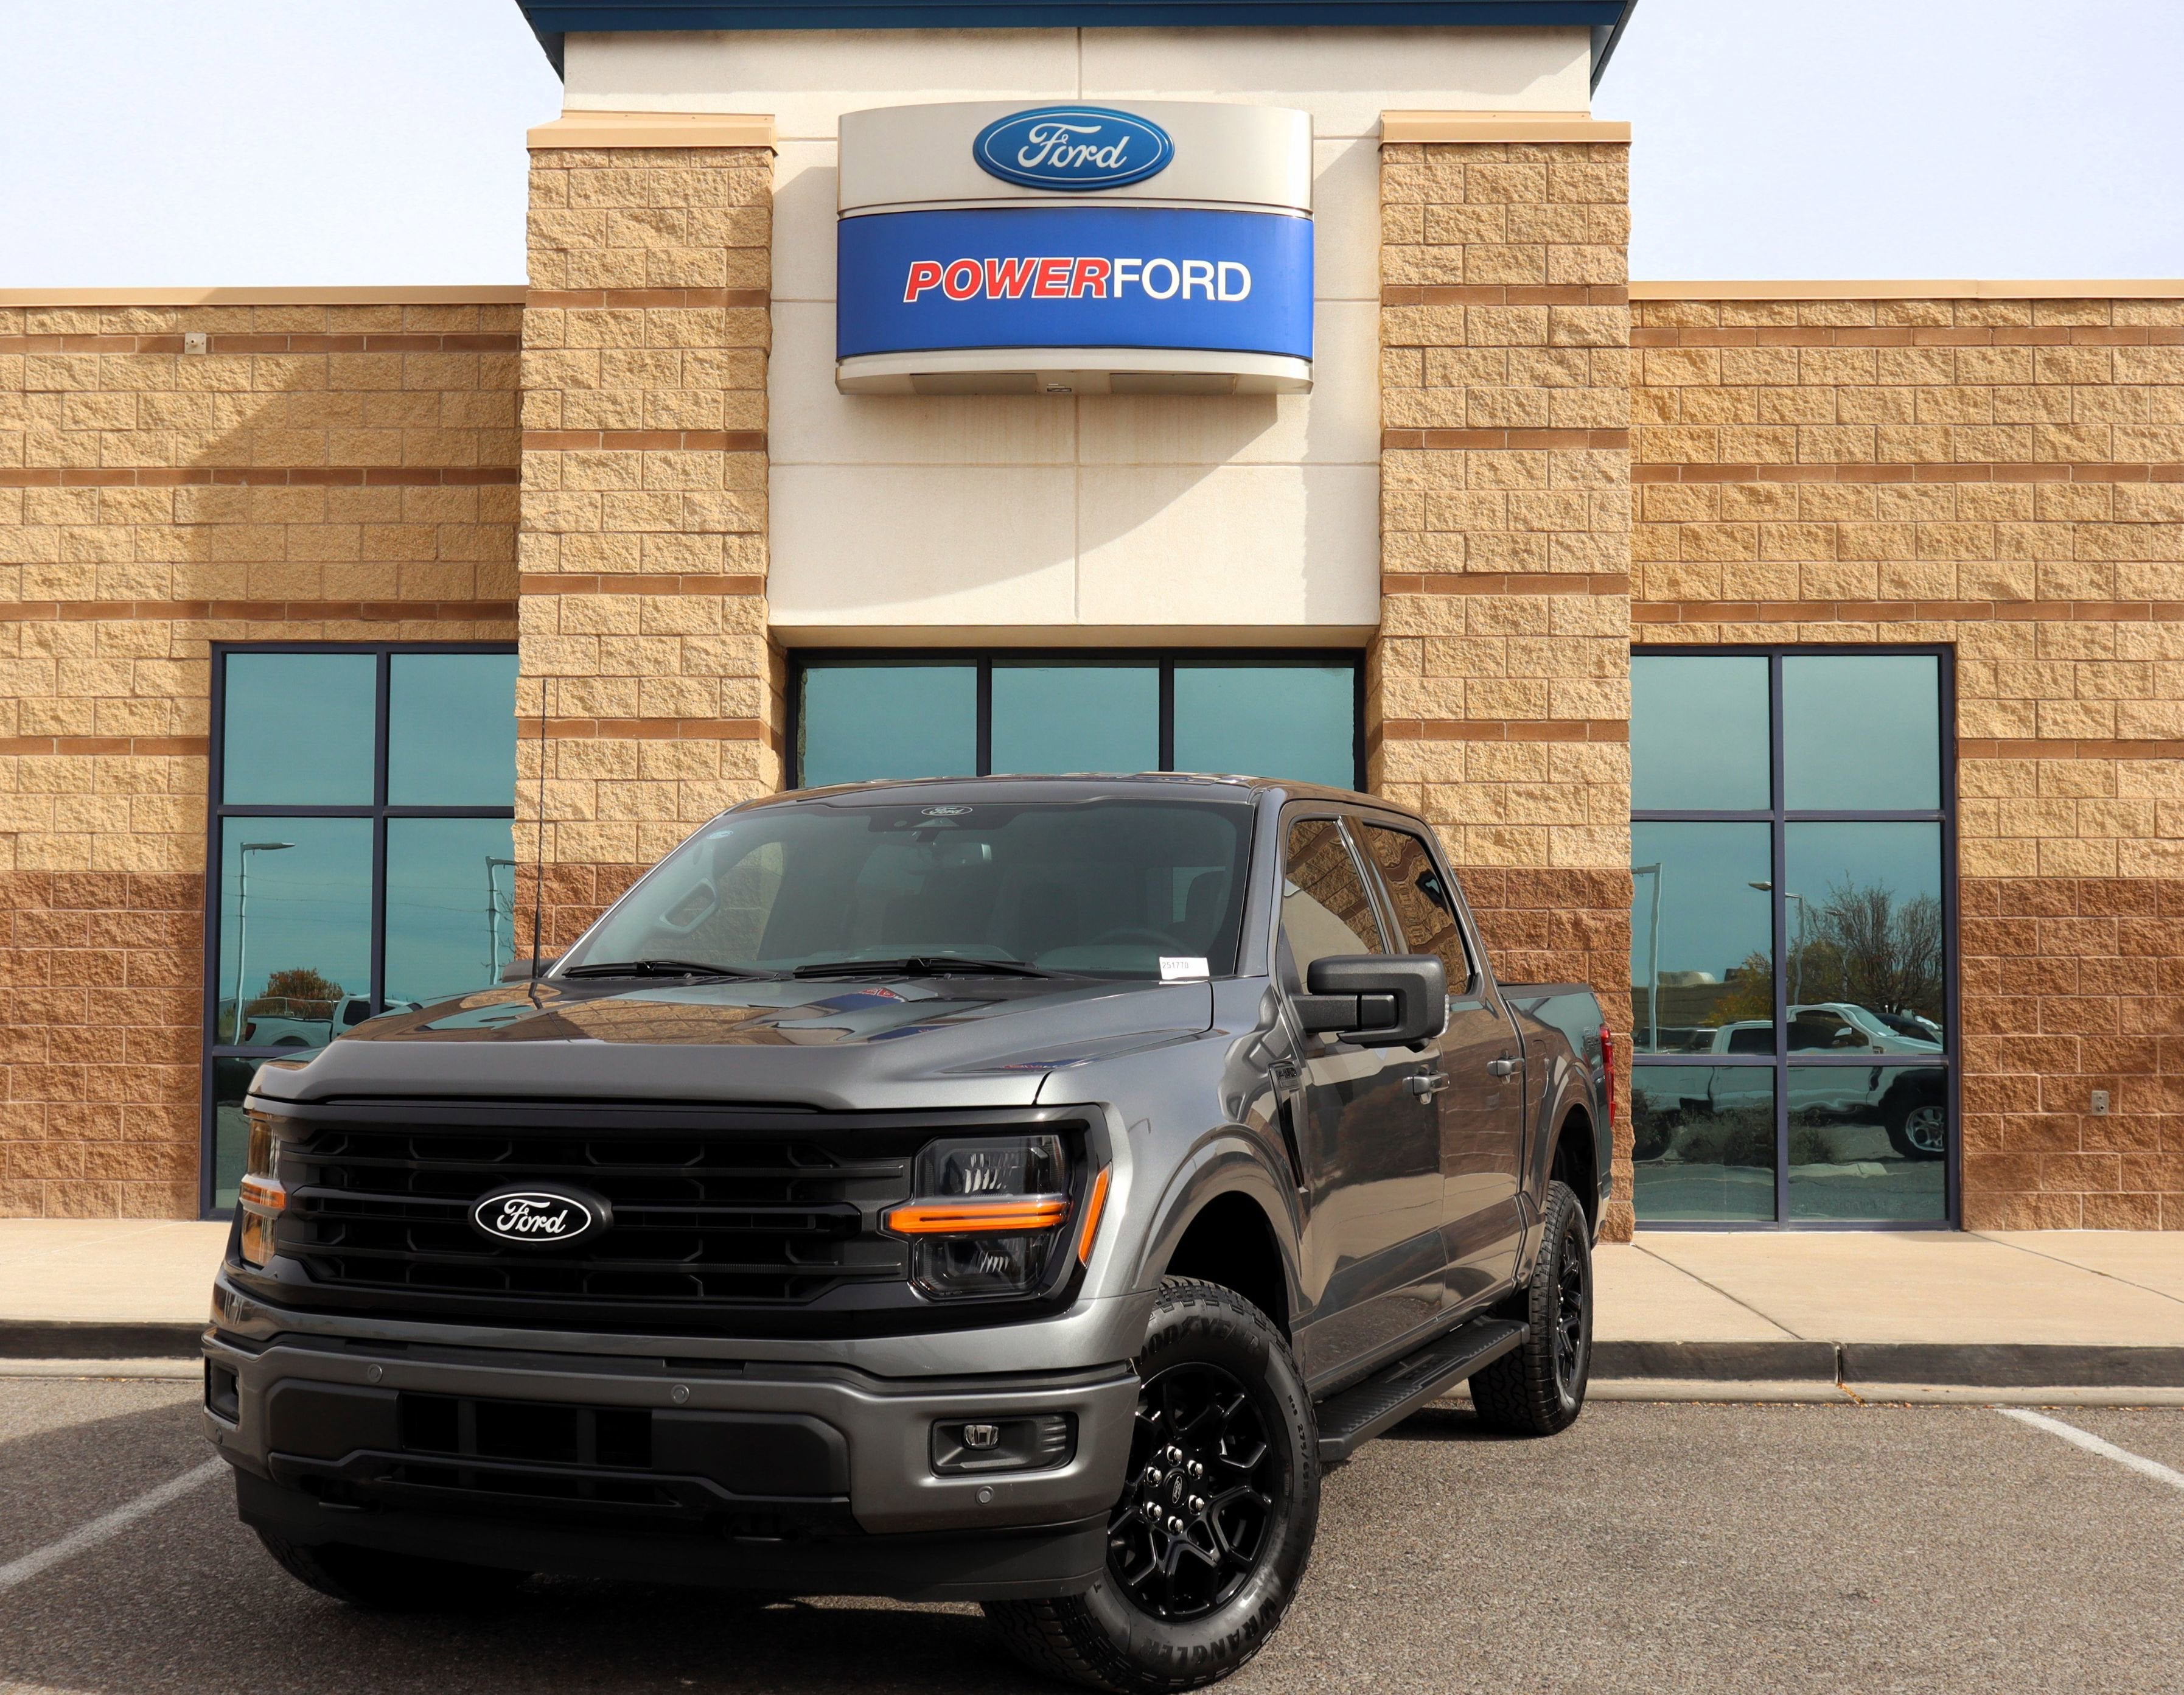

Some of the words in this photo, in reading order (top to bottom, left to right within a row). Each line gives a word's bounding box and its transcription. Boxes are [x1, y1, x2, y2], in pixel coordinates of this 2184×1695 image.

[1017, 122, 1130, 169] Ford
[929, 806, 965, 815] Ford
[1162, 961, 1189, 970] 251770
[496, 1198, 568, 1234] Ford
[1139, 1596, 1277, 1665] WRANGLER
